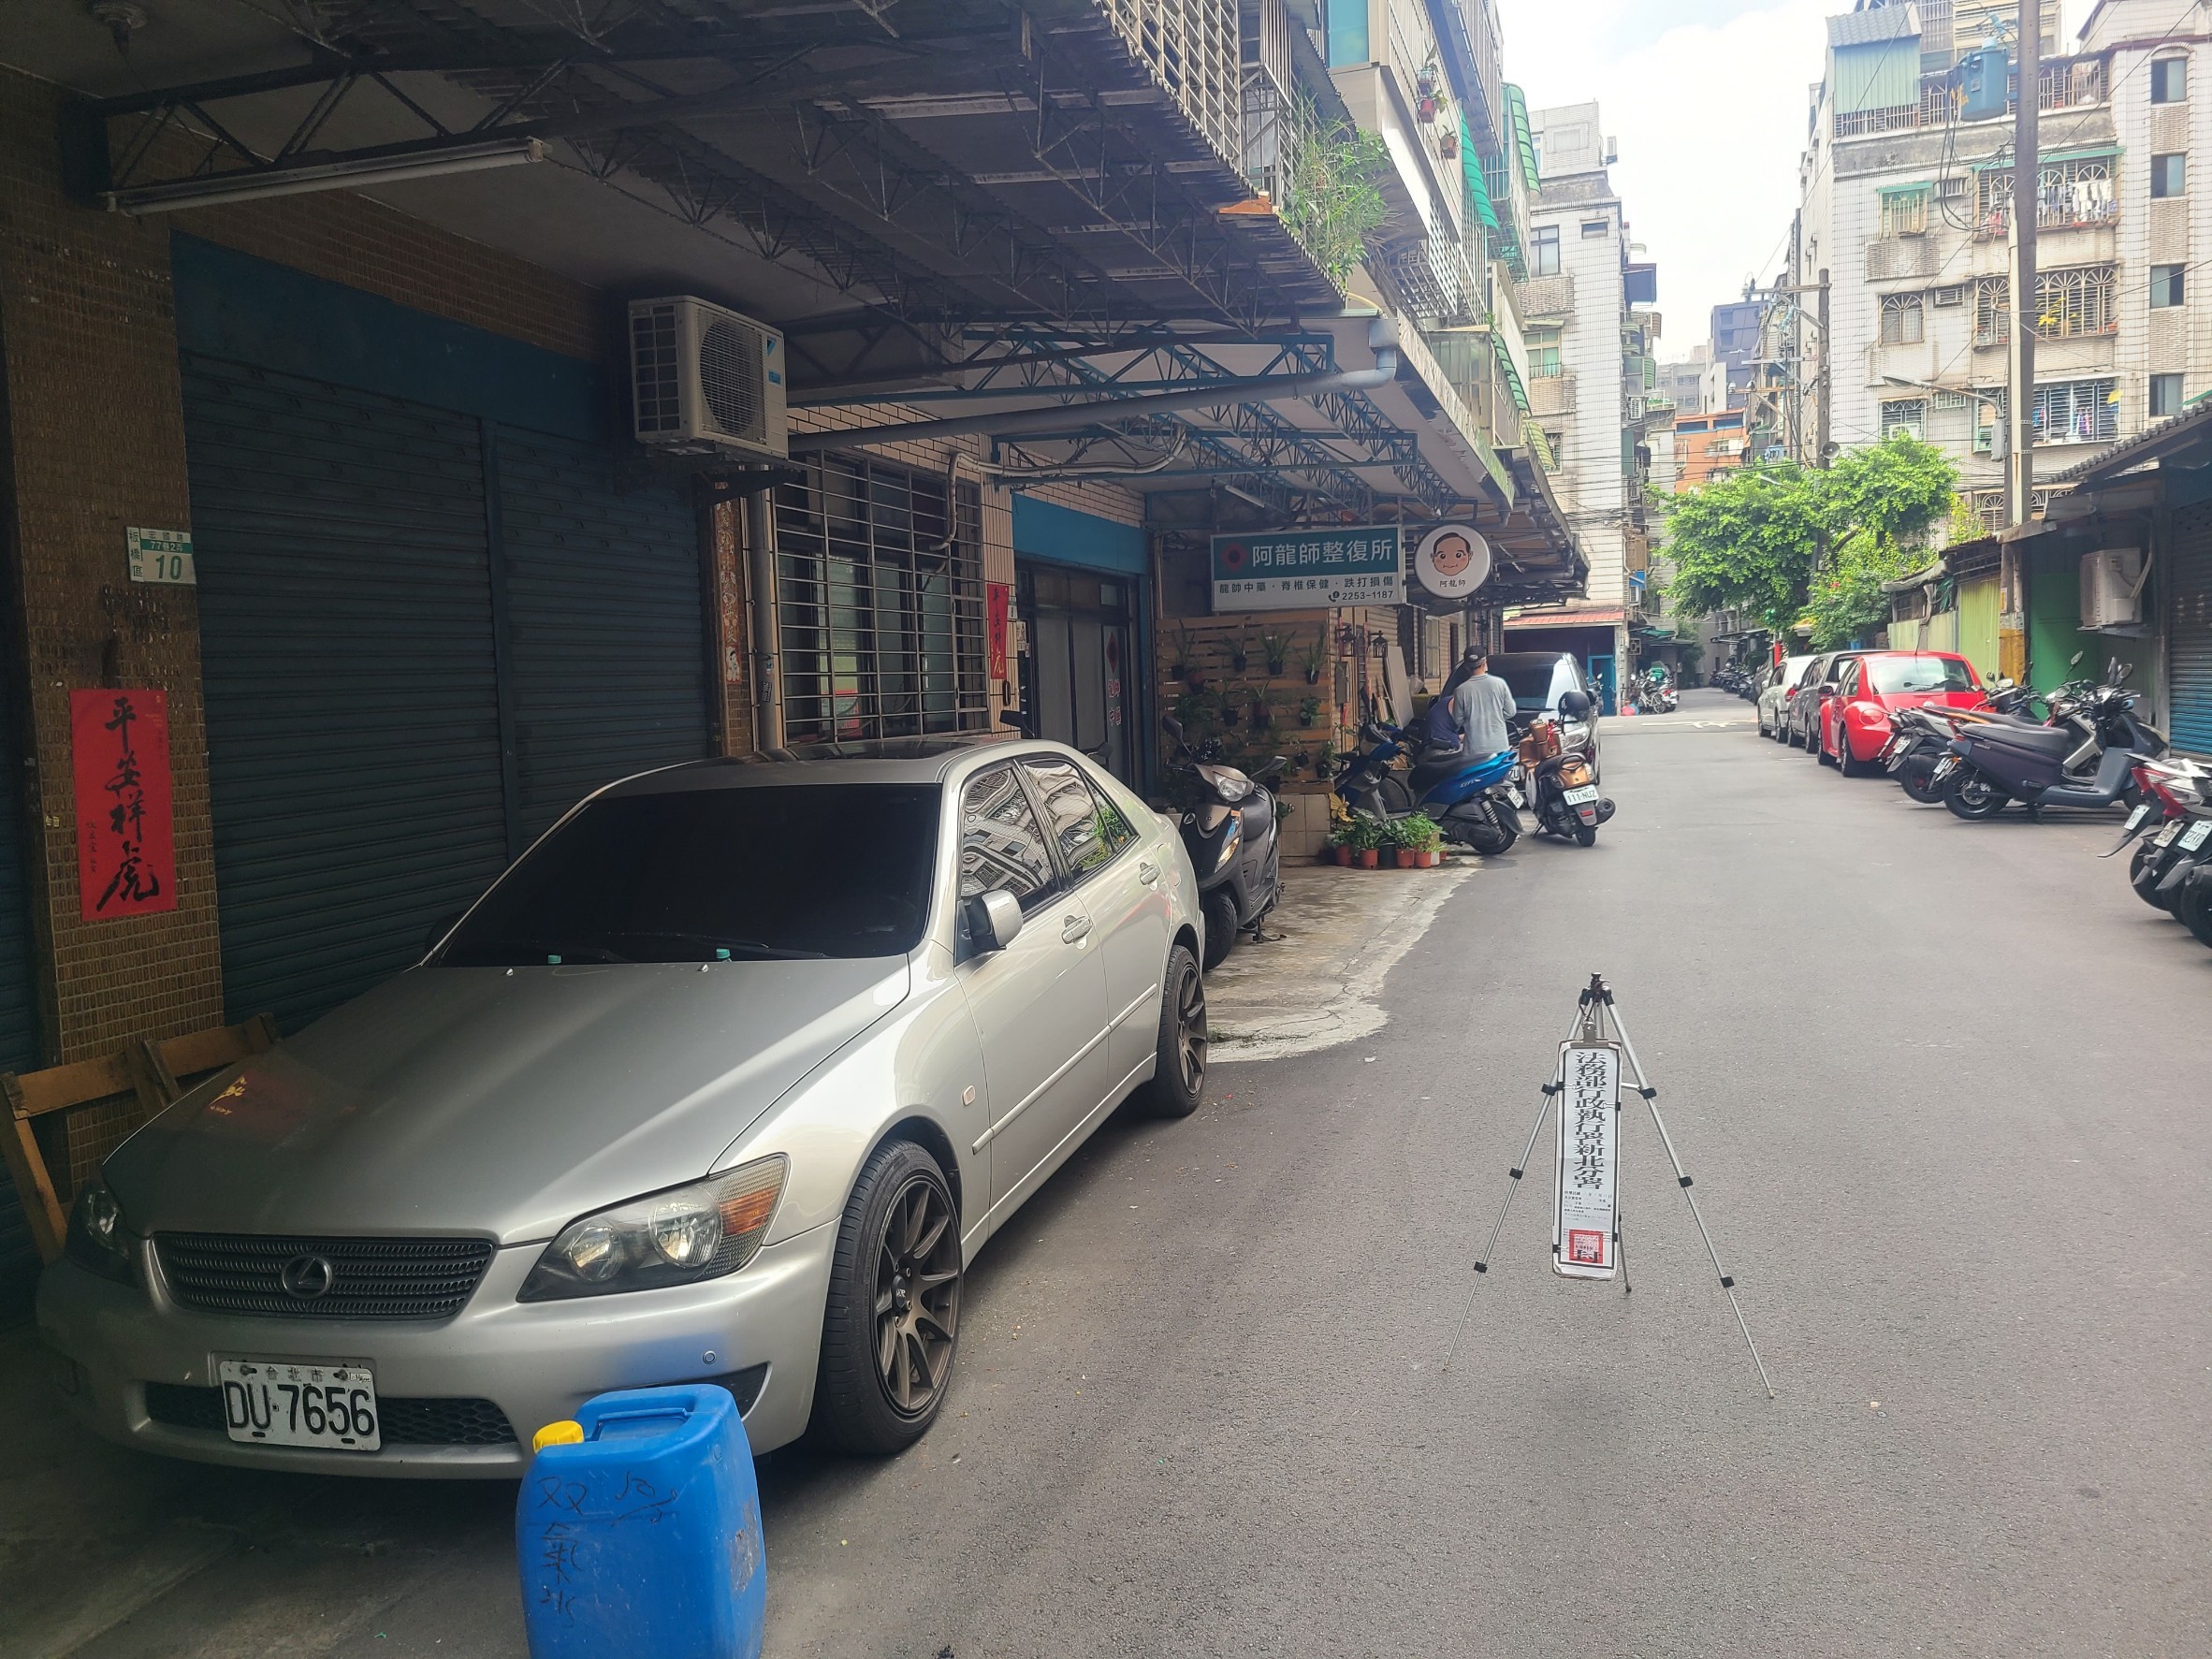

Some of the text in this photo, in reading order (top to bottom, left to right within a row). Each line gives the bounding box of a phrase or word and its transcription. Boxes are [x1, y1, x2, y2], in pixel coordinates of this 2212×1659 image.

[155, 554, 182, 580] 10
[1252, 539, 1393, 568] 阿龍師整復所
[1342, 590, 1393, 601] 2253-1187
[1573, 1052, 1607, 1190] 法務部行政執行署新北分署
